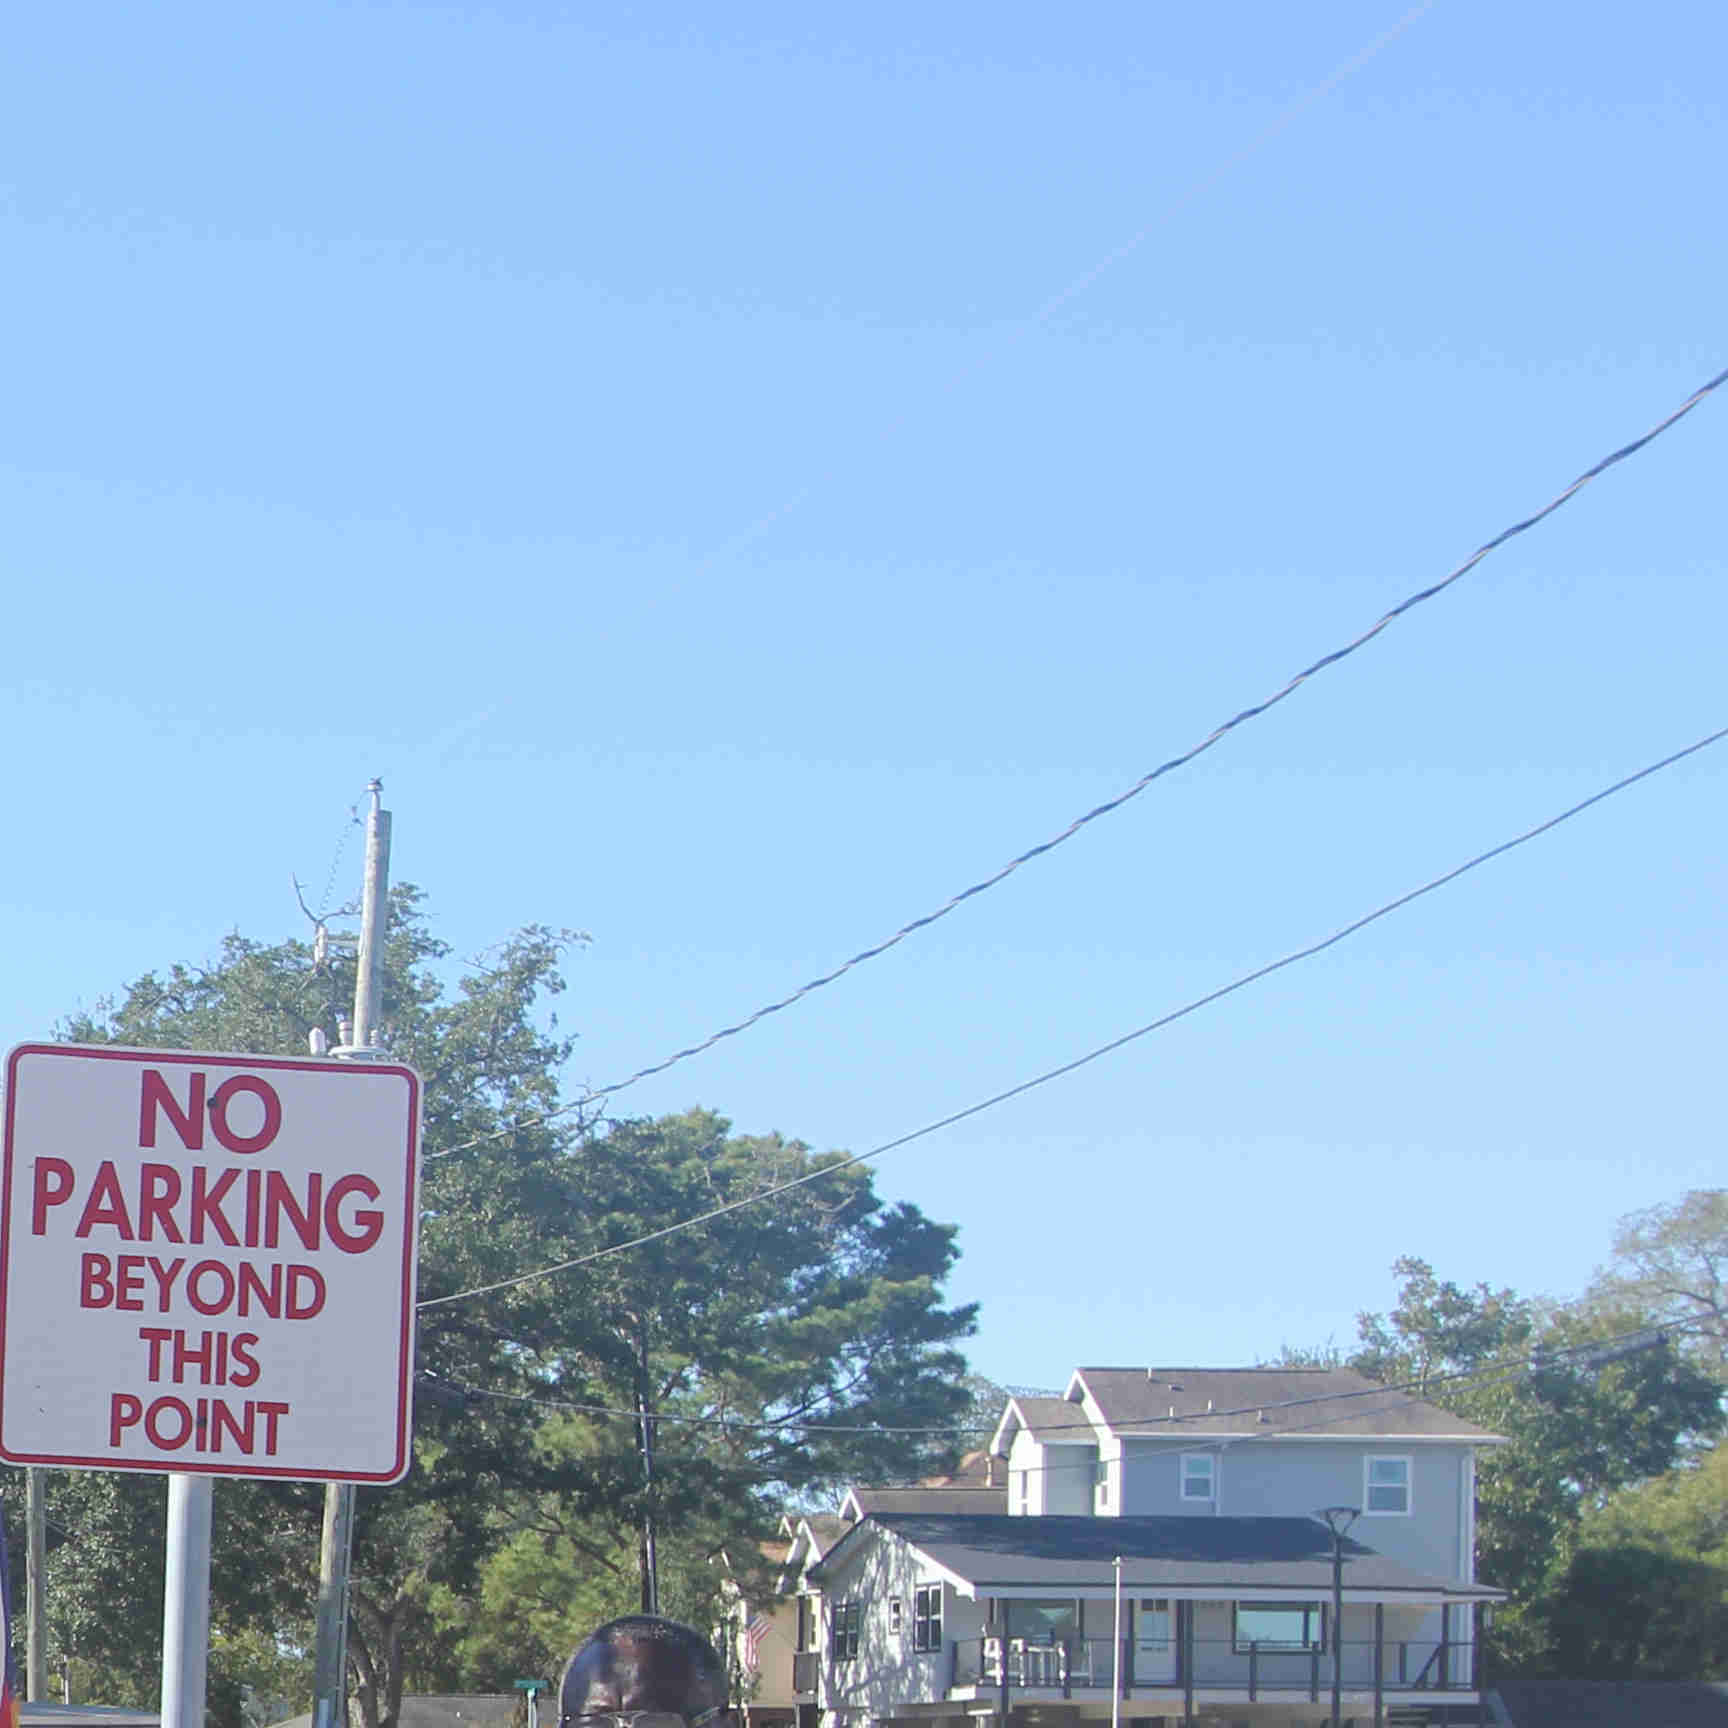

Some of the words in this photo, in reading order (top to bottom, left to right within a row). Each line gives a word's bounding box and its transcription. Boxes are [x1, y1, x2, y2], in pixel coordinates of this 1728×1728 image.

[138, 1068, 282, 1154] NO
[31, 1156, 384, 1254] PARKING
[80, 1252, 326, 1320] BEYOND
[139, 1327, 261, 1387] THIS
[109, 1393, 289, 1456] POINT
